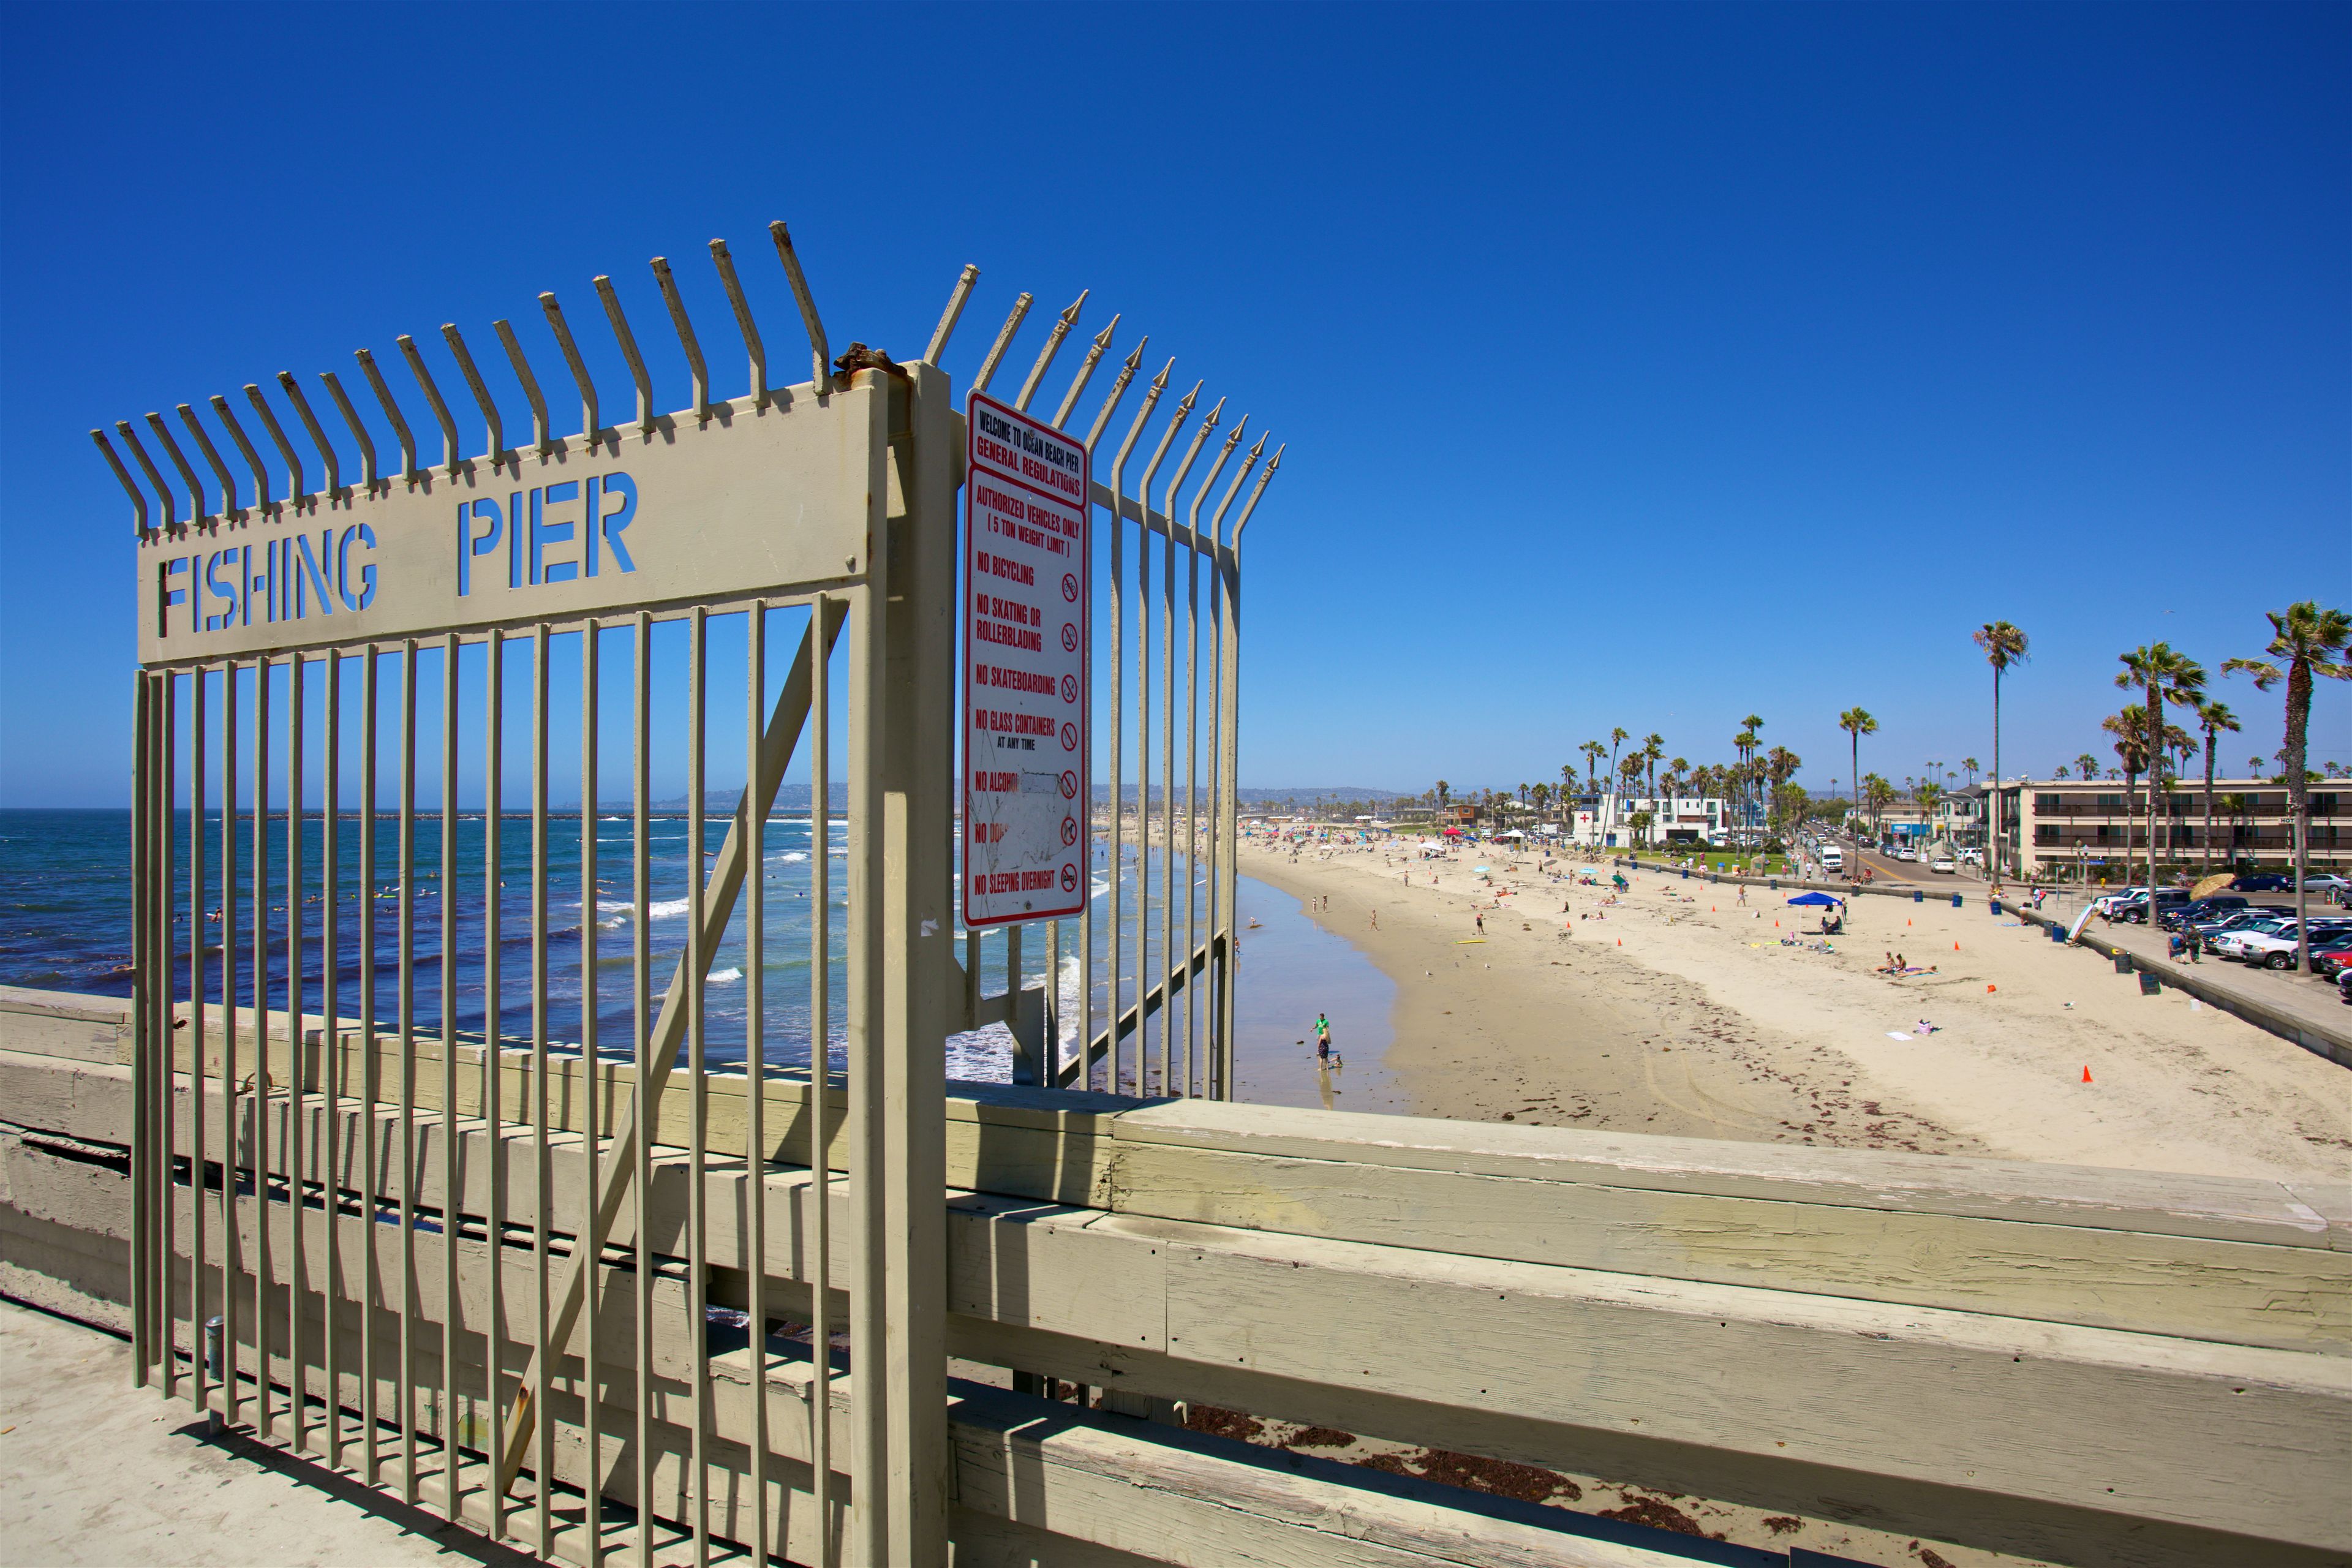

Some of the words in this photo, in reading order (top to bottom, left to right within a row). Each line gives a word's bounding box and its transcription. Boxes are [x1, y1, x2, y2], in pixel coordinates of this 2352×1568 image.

[980, 410, 1011, 443] WELCOME
[1013, 426, 1021, 448] TO
[1023, 432, 1043, 458] OCEAN
[1046, 442, 1064, 467] BEACH
[1066, 451, 1079, 473] PIER
[977, 436, 1019, 472] GENERAL
[1022, 456, 1080, 497] REGULATIONS
[976, 485, 1025, 520] AUTHORIZED
[1027, 505, 1060, 533] VEHICLES
[1063, 518, 1079, 540] ONLY
[1002, 519, 1016, 539] TON
[1018, 526, 1044, 549] WEIGHT
[1047, 535, 1065, 556] LIMIT
[158, 522, 377, 638] FISHING
[458, 472, 638, 597] PIER
[978, 551, 989, 573] NO
[992, 556, 1034, 586] BICYCLING
[976, 593, 989, 615] NO
[992, 597, 1027, 624] SKATING
[1030, 607, 1041, 628] OR
[976, 619, 1041, 652] ROLLERBLADING
[976, 663, 988, 685] NO
[991, 666, 1055, 696] SKATEBOARDING
[976, 709, 987, 729] NO
[990, 710, 1012, 733] GLASS
[1015, 714, 1055, 737] CONTAINERS
[997, 736, 1005, 748] AT
[1007, 737, 1019, 750] ANY
[1022, 738, 1035, 750] TIME
[975, 771, 987, 792] NO
[975, 823, 987, 843] NO
[975, 874, 986, 895] NO
[989, 872, 1019, 894] SLEEPING
[1021, 869, 1055, 891] OVERNIGHT
